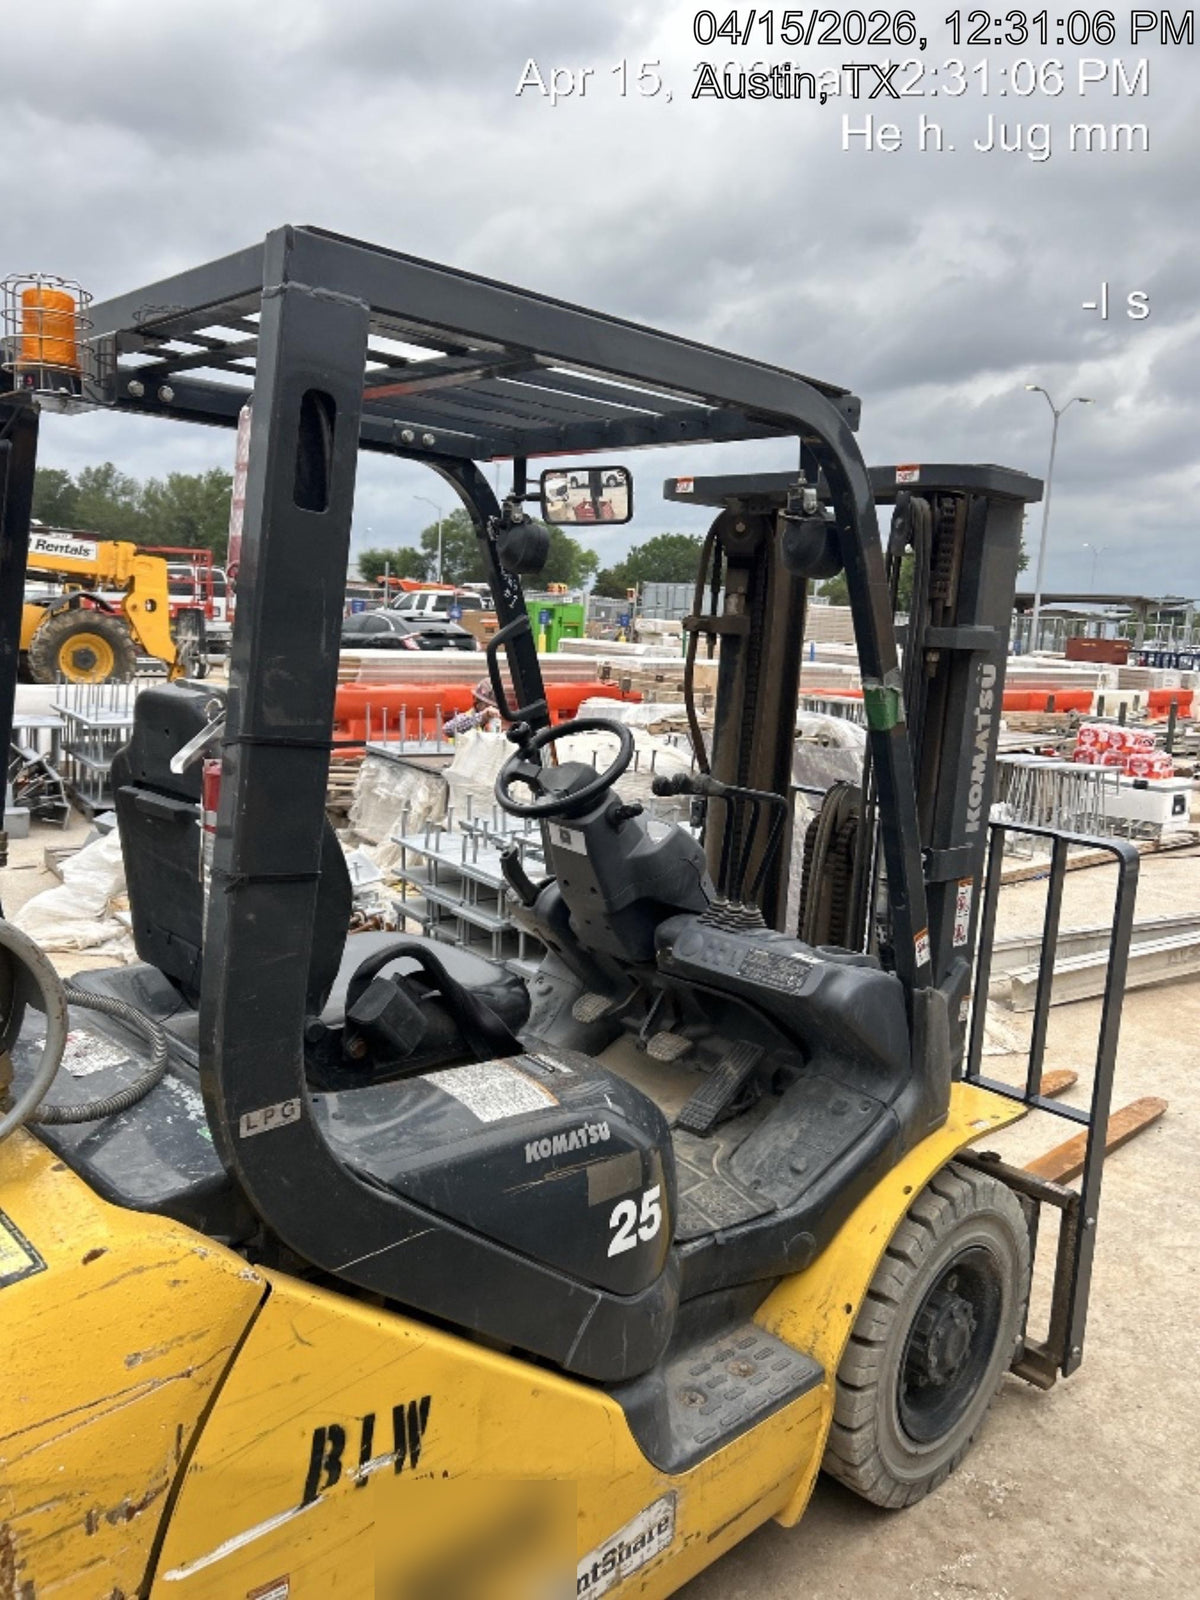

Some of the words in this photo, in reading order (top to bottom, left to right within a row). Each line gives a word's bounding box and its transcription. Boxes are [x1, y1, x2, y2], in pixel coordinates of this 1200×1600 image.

[34, 538, 91, 557] Rentals
[964, 662, 997, 833] KOMATSU
[524, 1121, 611, 1164] KOMATSU
[607, 1183, 663, 1258] 25
